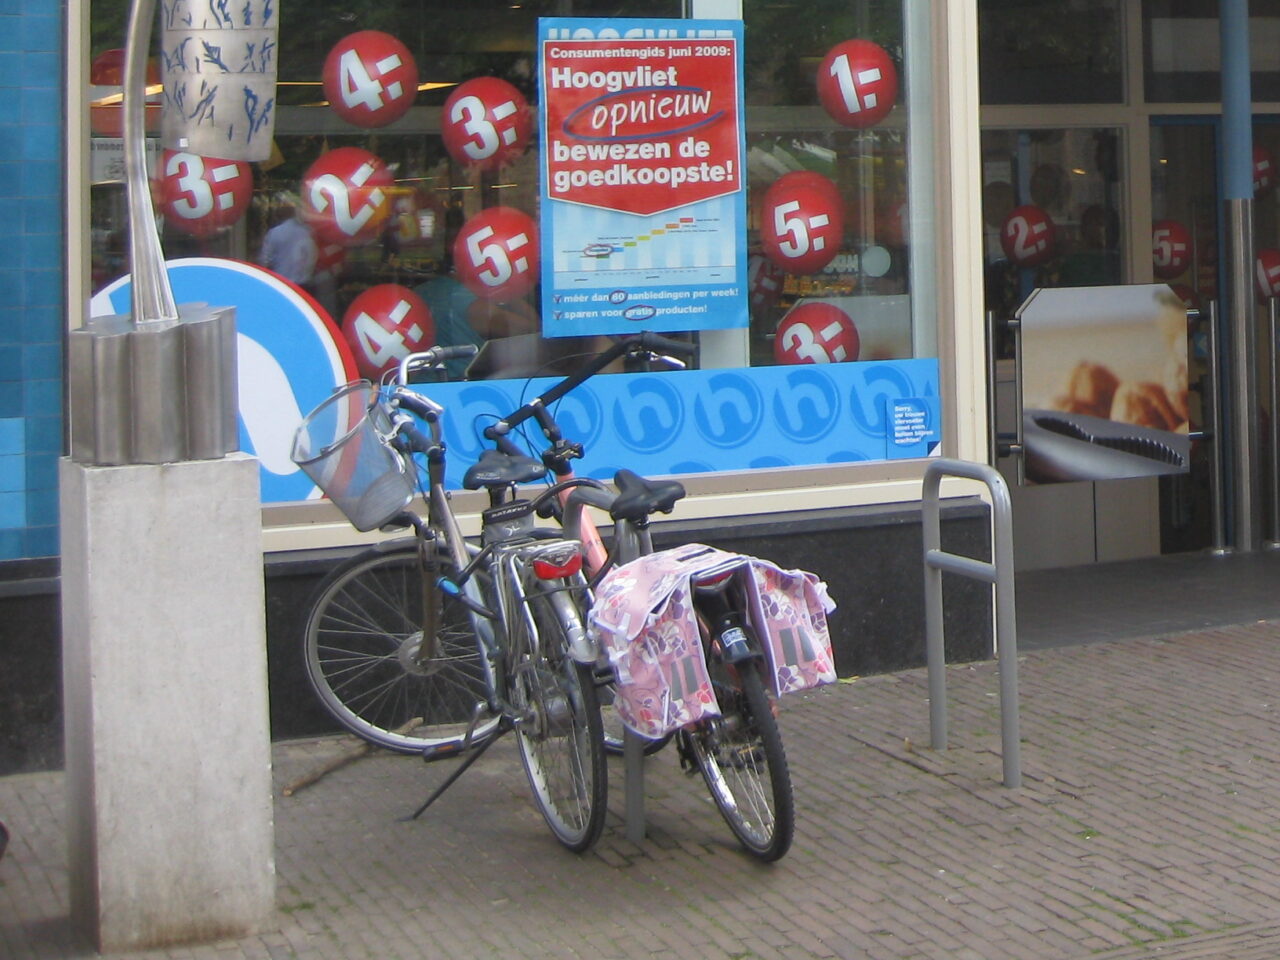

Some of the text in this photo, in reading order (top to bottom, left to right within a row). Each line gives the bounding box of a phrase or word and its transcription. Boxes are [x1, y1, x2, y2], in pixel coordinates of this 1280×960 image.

[550, 45, 731, 59] Consumentengids juni 2009:
[551, 65, 678, 93] Hoogvliet
[591, 90, 711, 136] opnieuw
[553, 137, 711, 162] bewezen de
[554, 160, 734, 192] goedkoopste!
[693, 290, 709, 301] per
[712, 288, 739, 297] week!
[564, 309, 599, 321] sparen
[601, 309, 624, 318] voor
[656, 304, 708, 317] producten!
